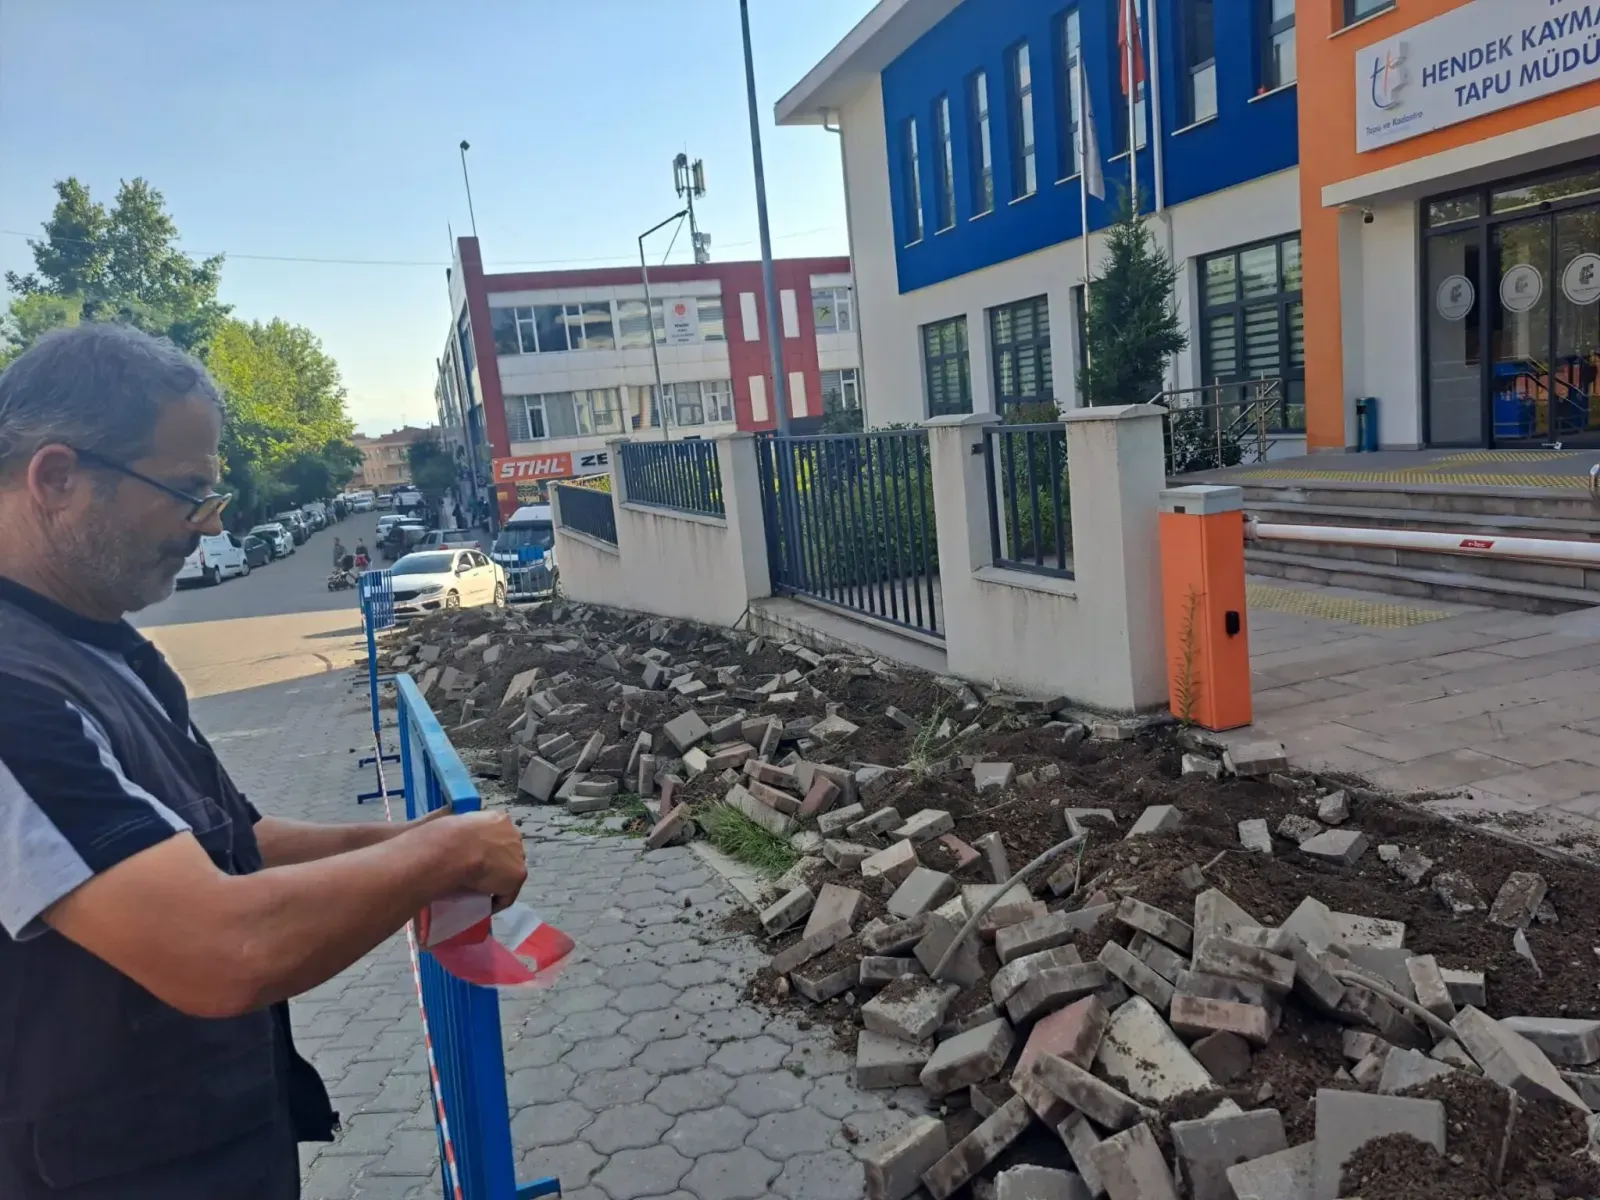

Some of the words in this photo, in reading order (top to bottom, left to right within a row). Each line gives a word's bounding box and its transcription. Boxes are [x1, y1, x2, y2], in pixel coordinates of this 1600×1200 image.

[1422, 35, 1513, 88] HENDEK
[1455, 69, 1511, 107] TAPU
[1519, 33, 1600, 87] MÜDÜ
[1366, 126, 1381, 135] Tapu
[1392, 111, 1423, 126] Kadastro
[501, 458, 565, 478] STIHL
[581, 453, 608, 467] ZE
